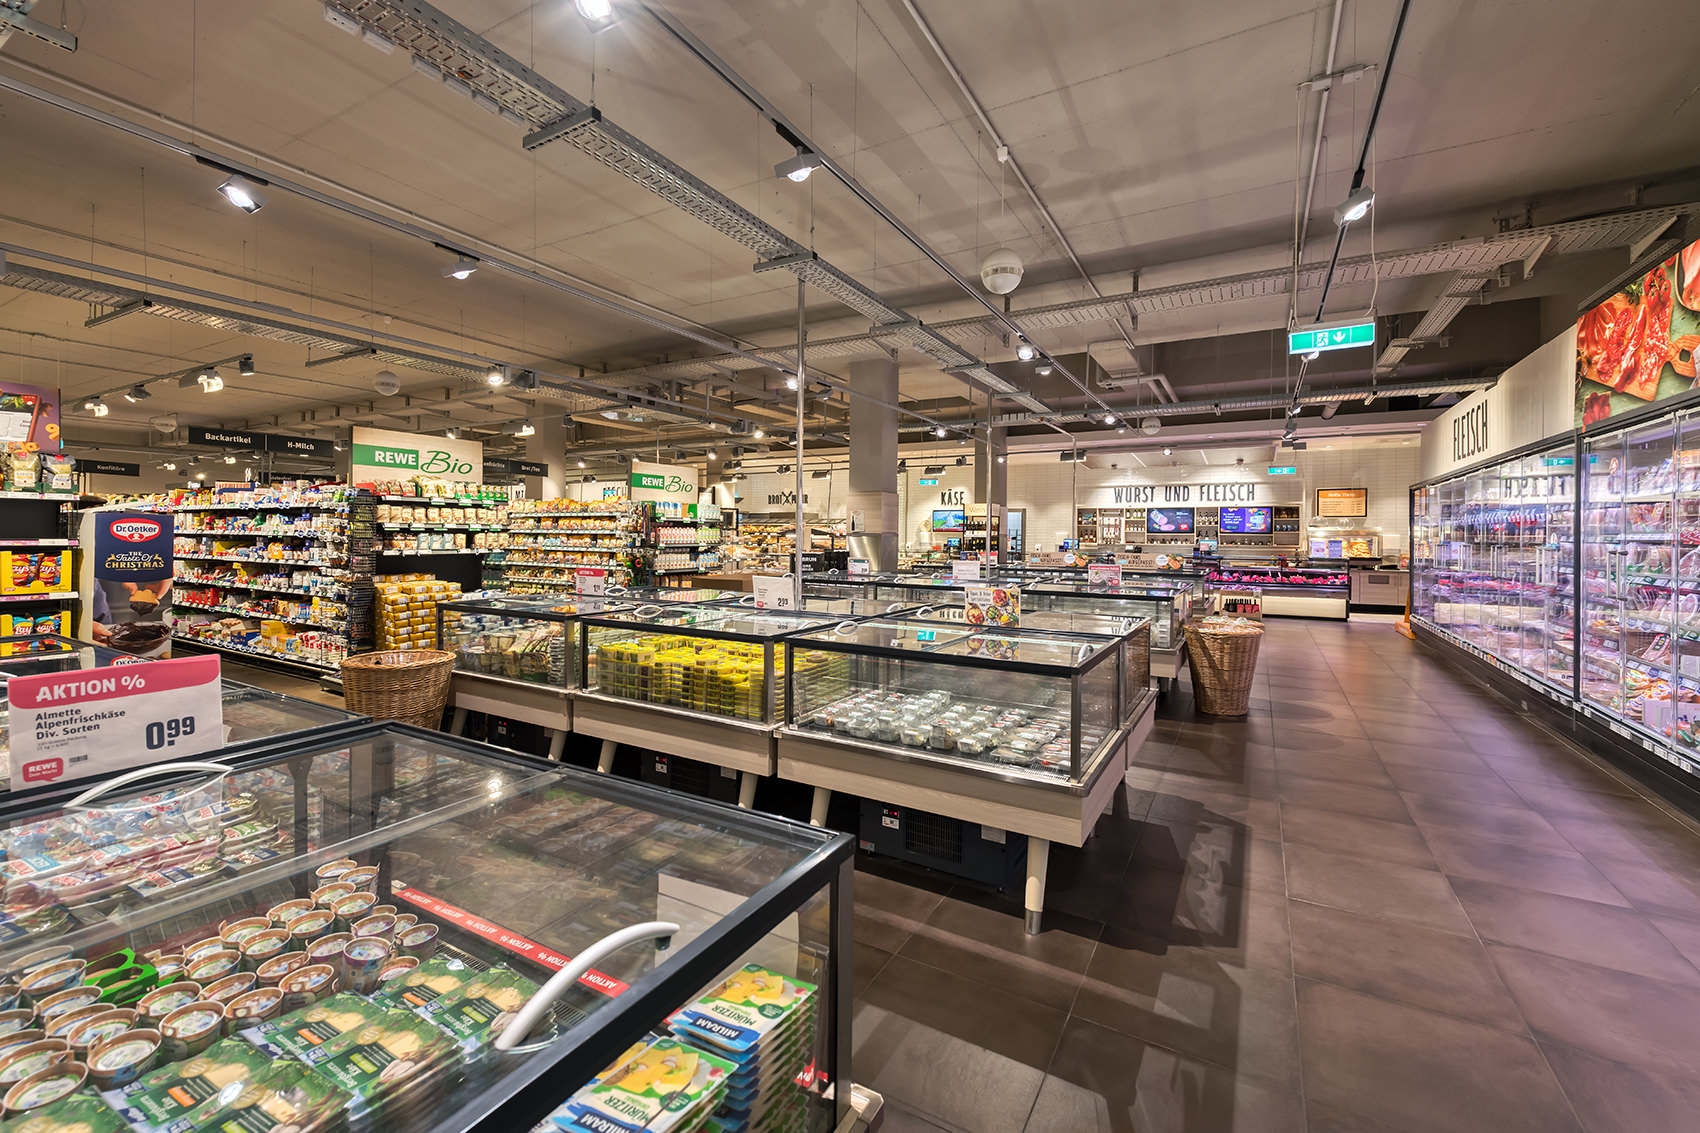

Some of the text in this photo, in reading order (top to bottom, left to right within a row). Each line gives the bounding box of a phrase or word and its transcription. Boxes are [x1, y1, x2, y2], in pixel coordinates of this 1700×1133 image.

[205, 432, 252, 444] Backartikel
[1453, 399, 1488, 462] FLEISCH
[287, 441, 315, 450] H-Milch
[97, 464, 126, 472] Konfitüre
[374, 450, 473, 475] REWE Bio
[641, 475, 693, 493] REWE Bio
[768, 494, 783, 504] BROT
[791, 494, 809, 505] MR
[941, 489, 965, 506] KÄSE
[1113, 483, 1255, 504] WURST UND FLEISCH
[105, 561, 165, 569] CHRISTMAS
[35, 674, 146, 702] AKTION %
[35, 708, 81, 721] Almette
[35, 709, 126, 730] Alpenfrischkäse
[36, 723, 100, 740] Div. Sorten
[145, 716, 196, 750] 0.99
[28, 761, 57, 773] REWE
[411, 893, 433, 904] AKTION
[441, 907, 465, 919] AKTION
[474, 922, 498, 934] AKTION
[509, 938, 535, 951] AKTION
[589, 973, 618, 989] AKTION
[711, 1004, 757, 1026] MÜRITZER
[696, 1017, 740, 1038] MILRAM
[603, 1095, 652, 1124] MÜRITZER
